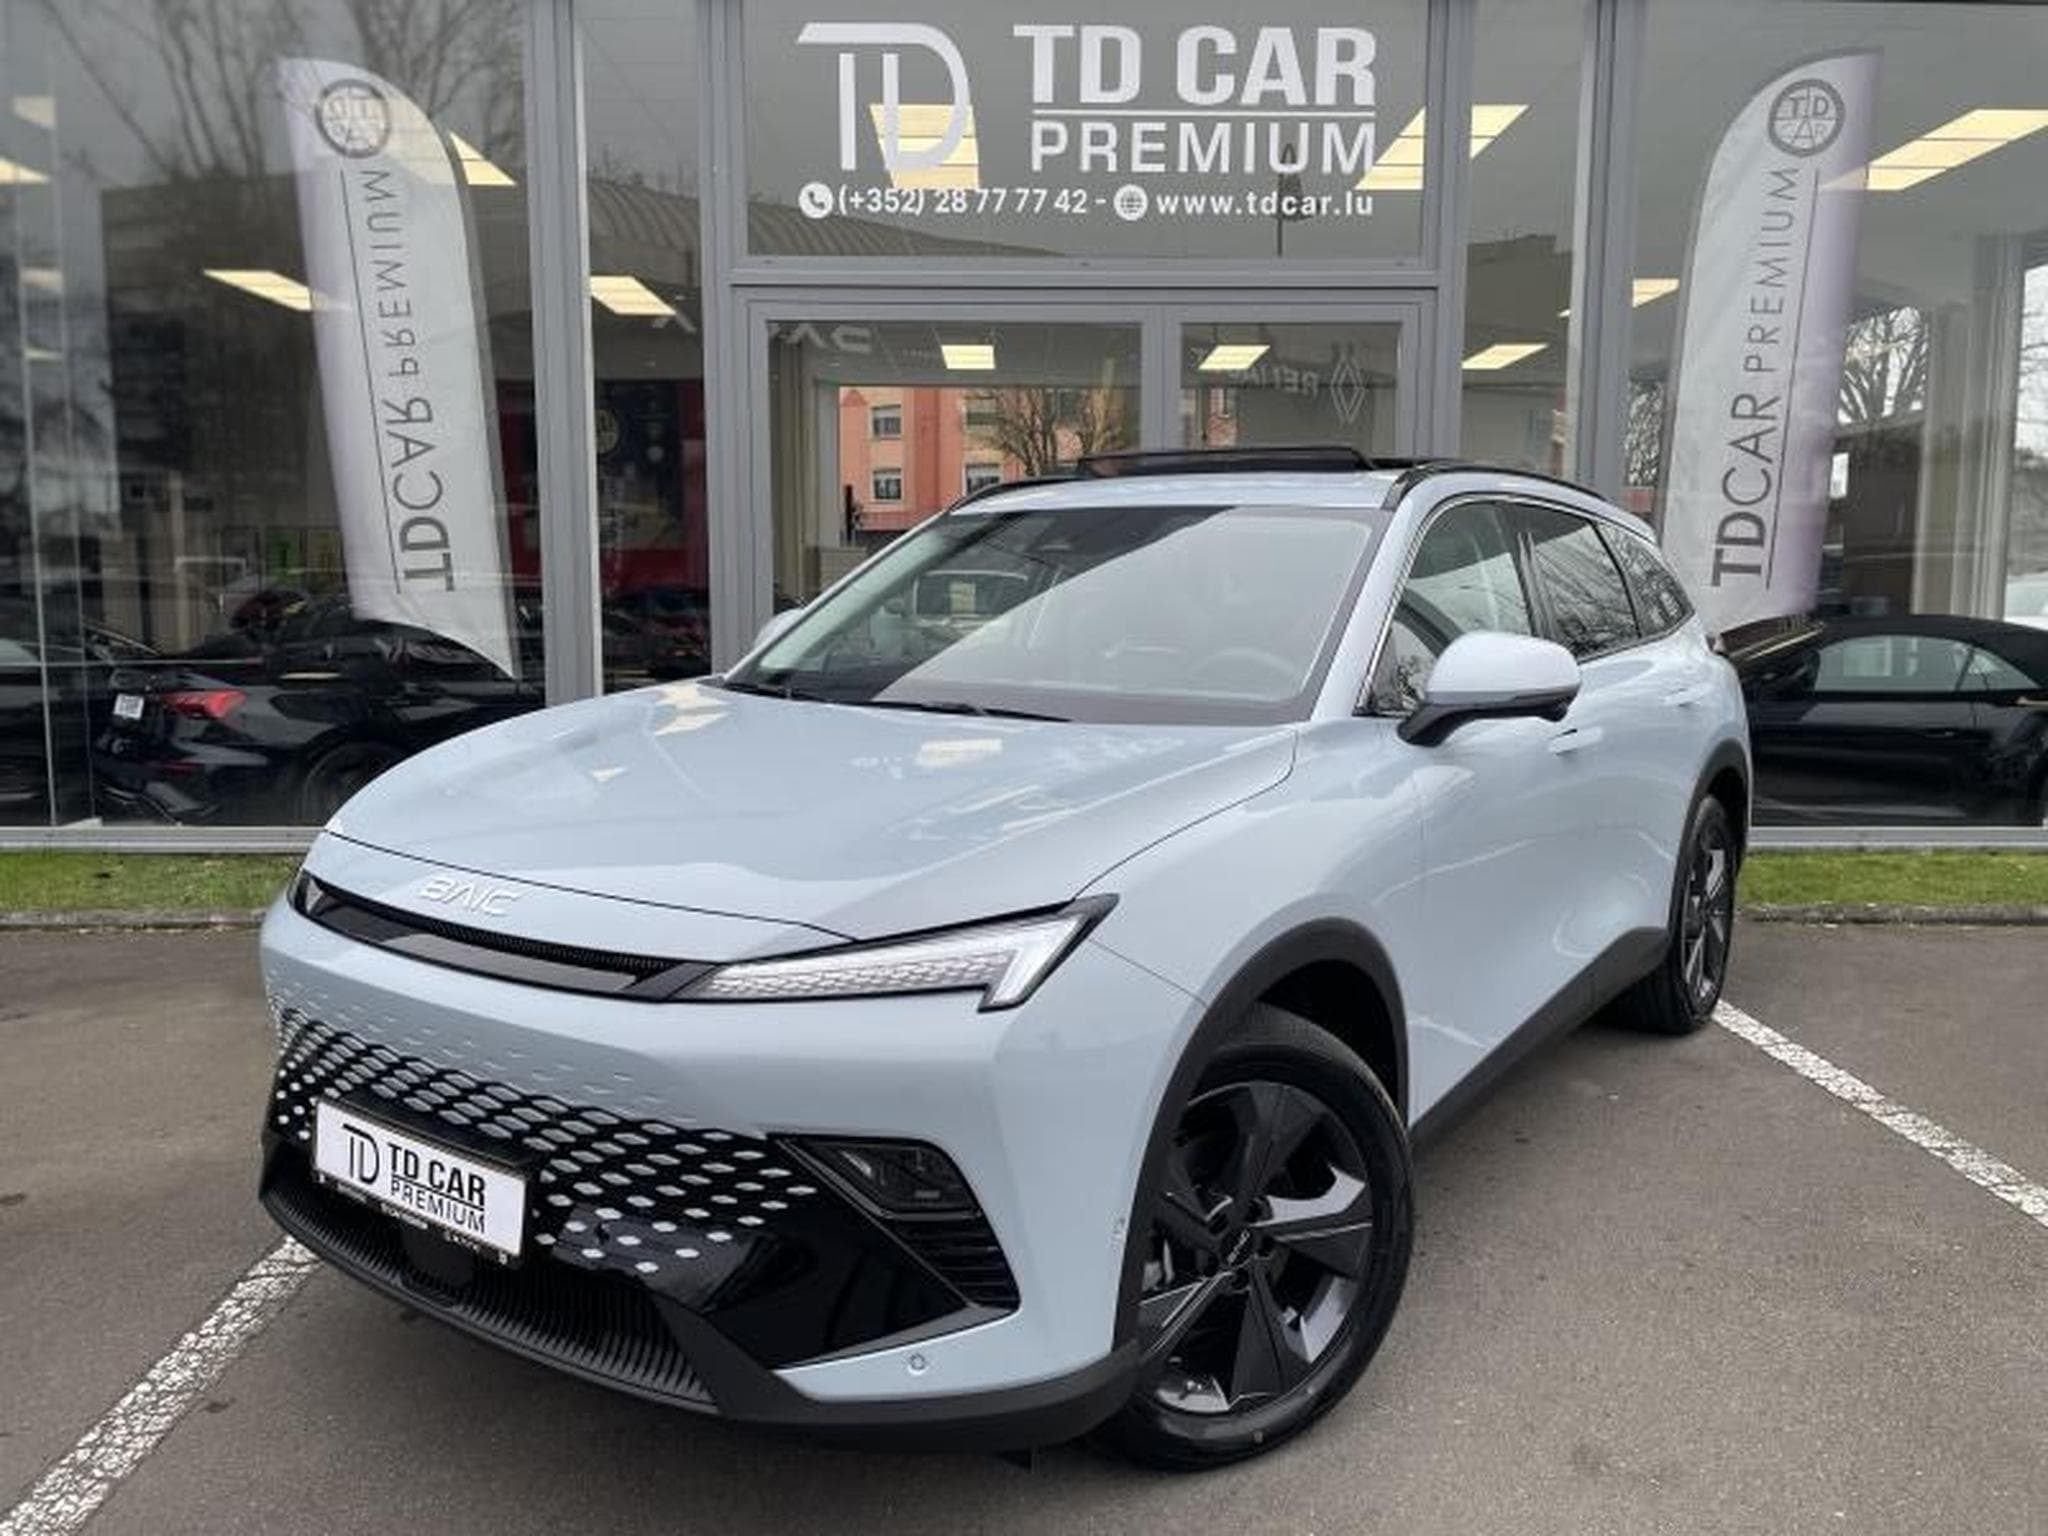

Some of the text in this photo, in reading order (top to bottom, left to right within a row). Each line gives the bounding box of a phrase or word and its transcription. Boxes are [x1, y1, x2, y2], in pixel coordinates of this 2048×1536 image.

[1013, 25, 1376, 106] TD CAR
[1031, 120, 1376, 174] PREMIUM
[839, 184, 925, 216] (+352)
[934, 188, 968, 214] 28
[973, 188, 1007, 214] 77
[1015, 188, 1048, 214] 77
[1053, 188, 1088, 214] 42
[1156, 191, 1374, 216] www.tdcar.lu
[1711, 167, 1800, 589] TDCAR PREMIUM
[418, 876, 521, 918] BAIC
[386, 1142, 486, 1207] TD CAR
[391, 1177, 485, 1234] PREMIUM
